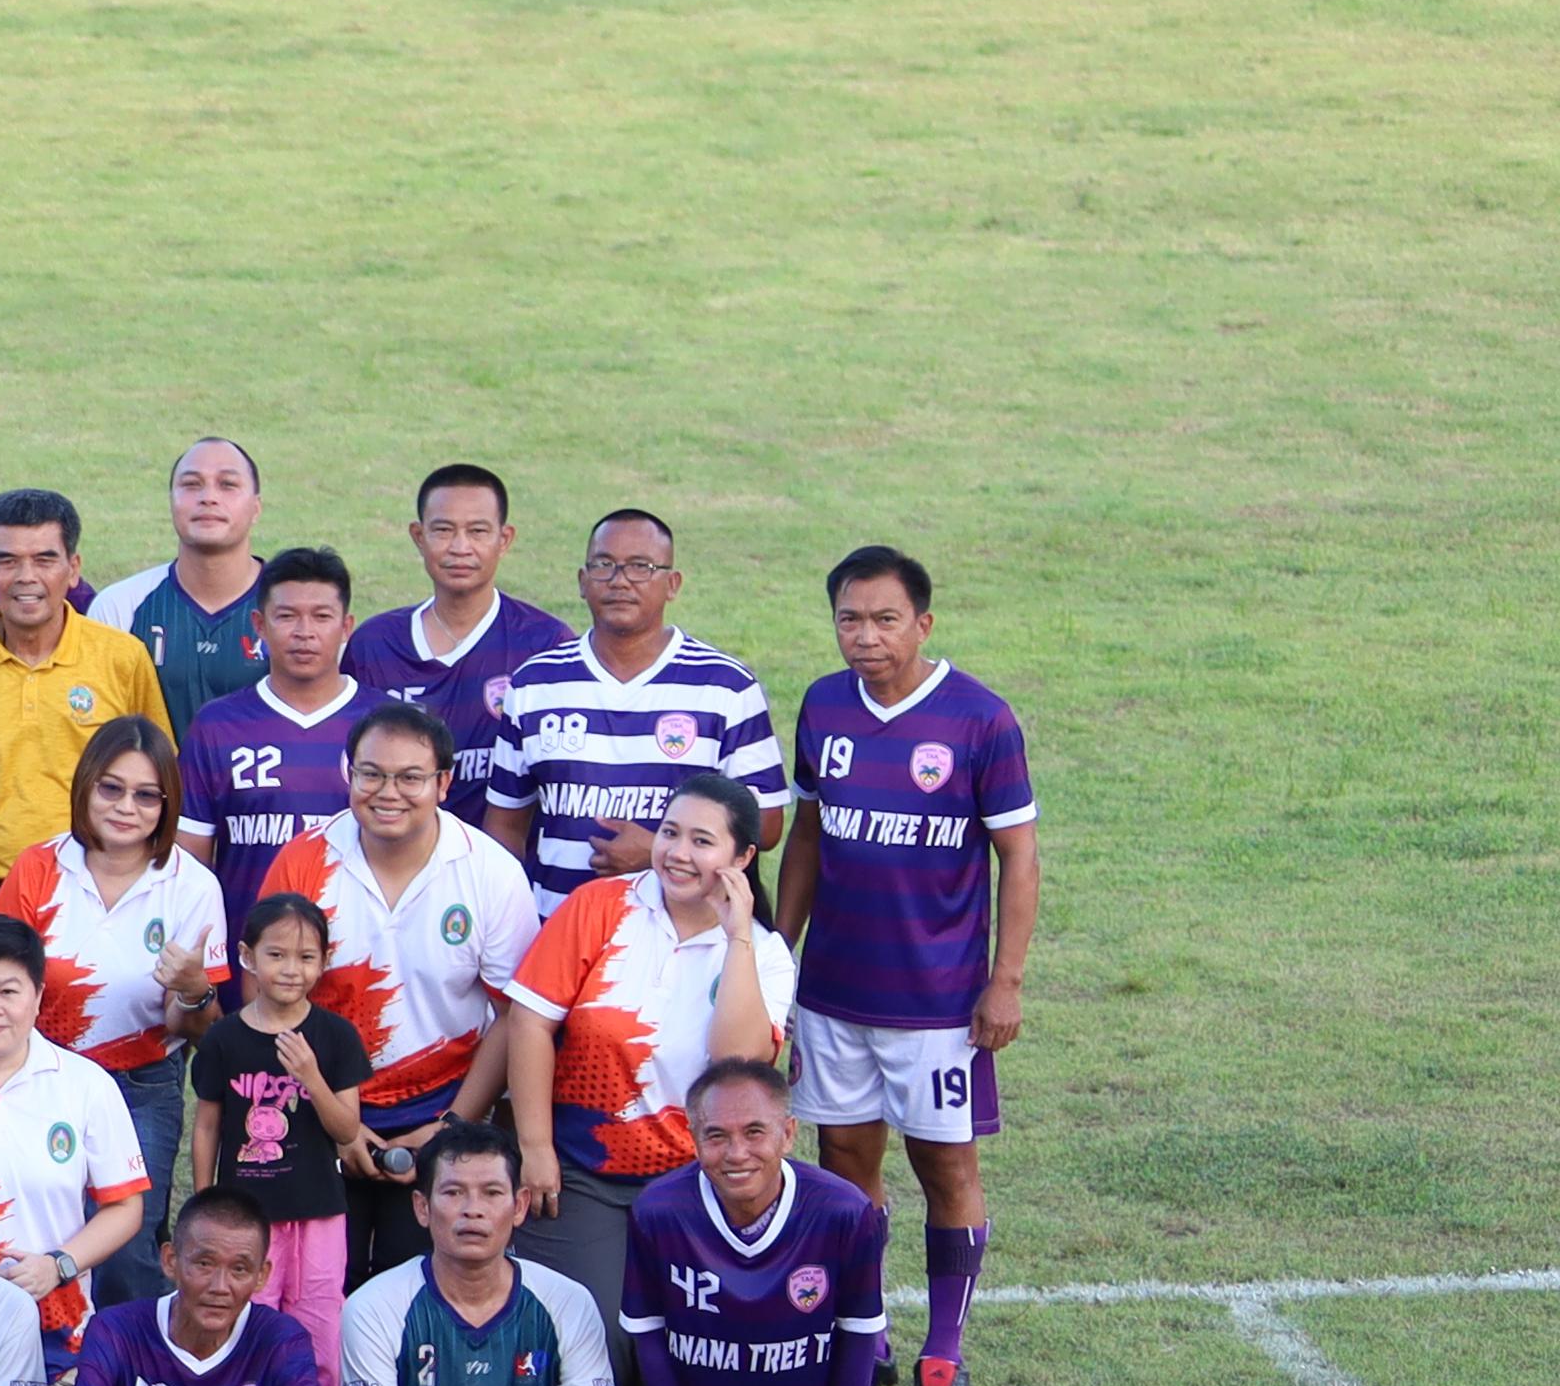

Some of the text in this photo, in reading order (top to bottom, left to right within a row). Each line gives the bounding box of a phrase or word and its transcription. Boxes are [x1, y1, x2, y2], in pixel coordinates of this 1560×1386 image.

[539, 712, 588, 753] 88
[231, 745, 282, 790] 22
[819, 735, 855, 779] 19
[866, 809, 923, 846] TREE
[931, 1066, 968, 1110] 19
[670, 1265, 721, 1314] 42
[668, 1331, 739, 1372] ANANA
[749, 1340, 809, 1374] TREE
